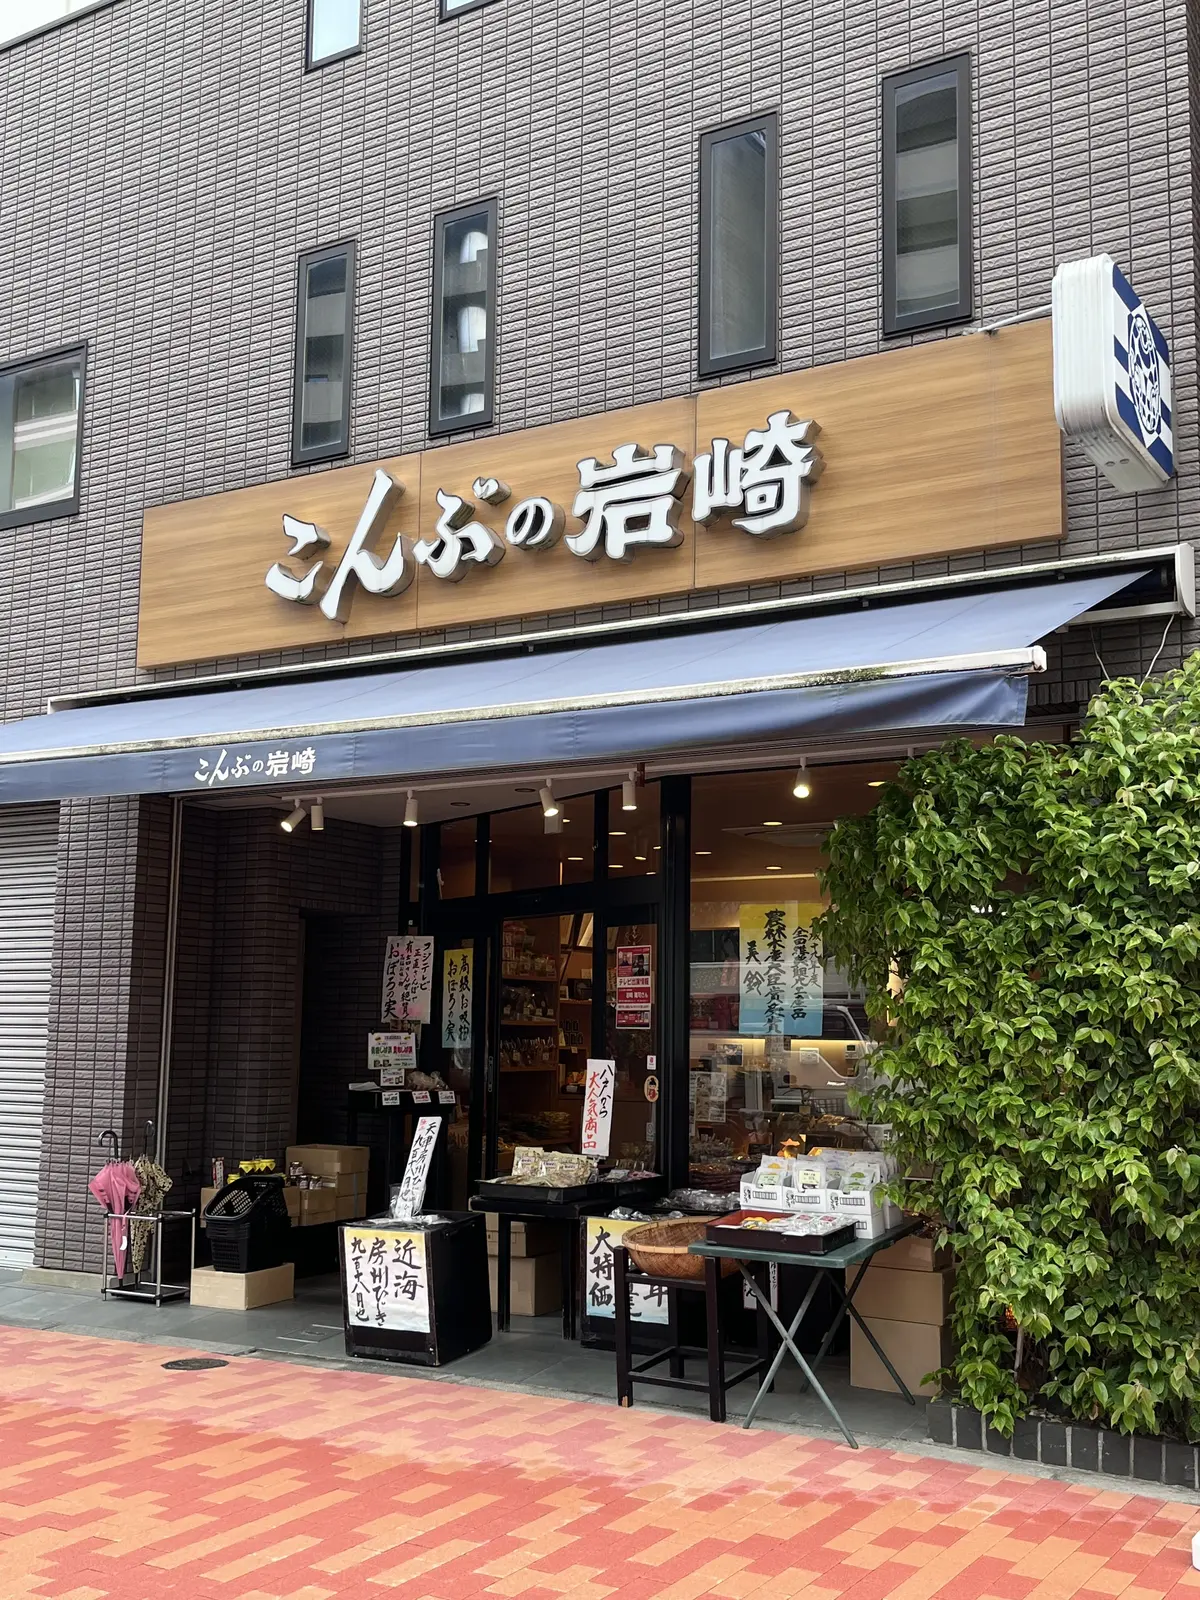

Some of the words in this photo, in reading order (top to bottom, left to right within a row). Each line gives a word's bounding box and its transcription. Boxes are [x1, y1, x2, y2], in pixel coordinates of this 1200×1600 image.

[265, 409, 819, 621] こんぶの岩崎
[194, 747, 316, 787] こんぶの岩崎
[420, 941, 432, 991] フジテレビ
[583, 1071, 600, 1149] 大人気商品
[598, 1064, 613, 1119] 八戸から
[351, 1237, 370, 1322] 九百十八円也
[367, 1237, 389, 1327] 房州ひじき
[392, 1238, 424, 1301] 近海
[589, 1226, 614, 1307] 大特価
